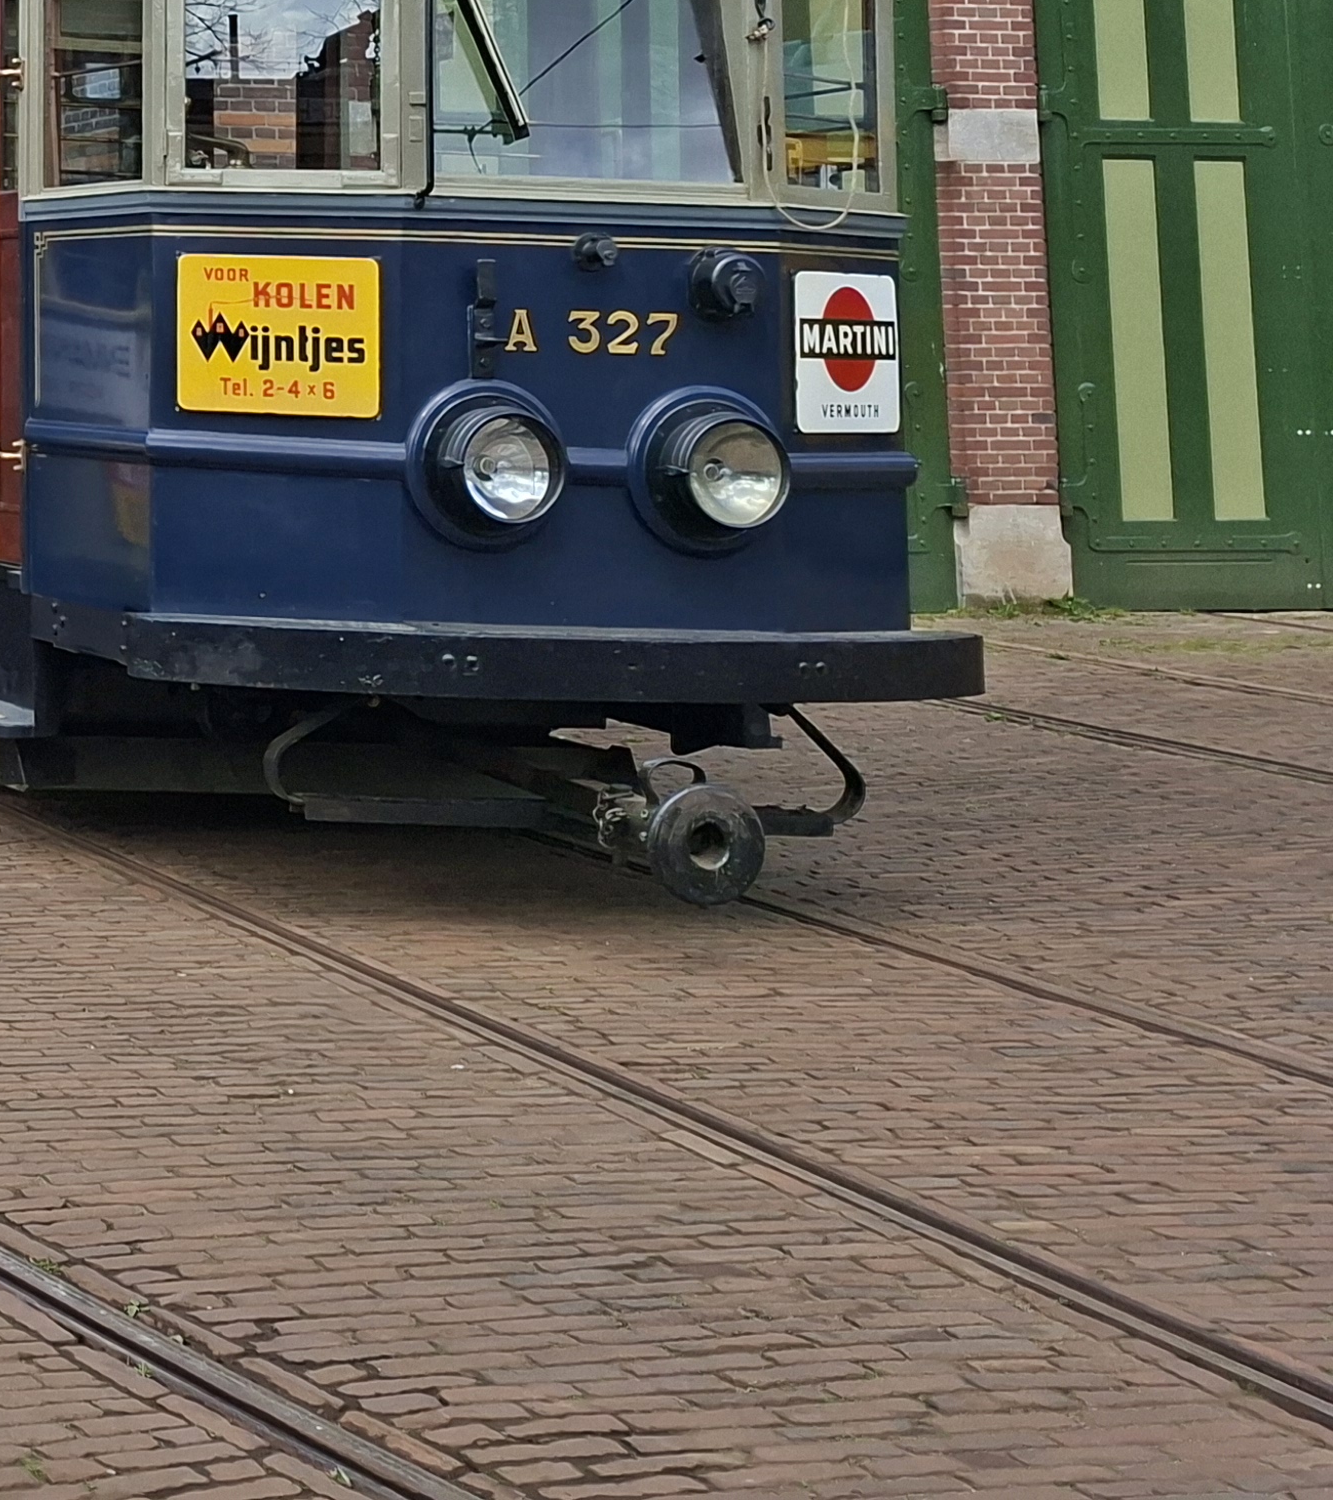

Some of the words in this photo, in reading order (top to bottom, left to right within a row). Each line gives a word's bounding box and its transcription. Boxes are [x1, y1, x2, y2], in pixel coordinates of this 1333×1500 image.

[204, 267, 250, 282] VOOR
[253, 281, 356, 311] KOLEN
[191, 311, 366, 373] Wijntjes
[503, 308, 539, 353] A
[567, 309, 680, 356] 327
[802, 323, 896, 356] MARTINI
[219, 377, 254, 397] Tel.
[821, 403, 880, 419] VERMOUTH
